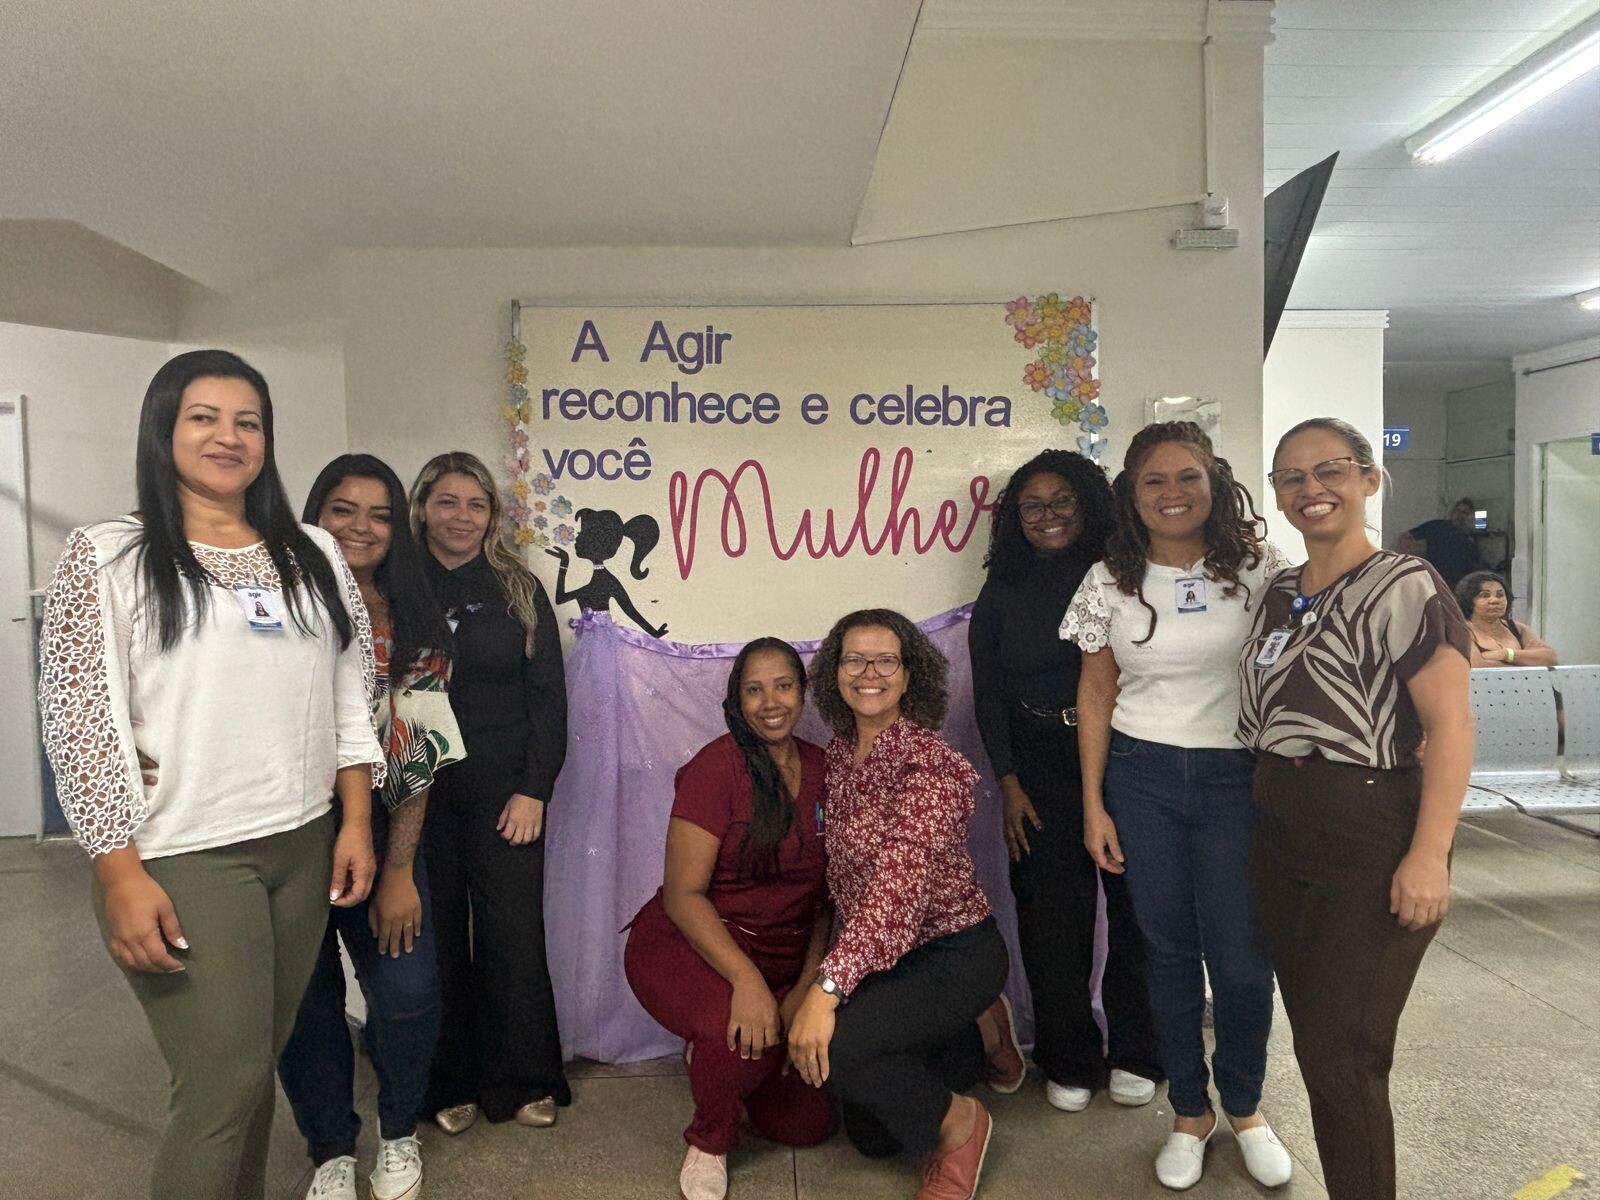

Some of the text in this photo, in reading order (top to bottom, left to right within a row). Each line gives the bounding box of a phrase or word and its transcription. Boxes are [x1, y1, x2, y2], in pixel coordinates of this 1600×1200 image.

[571, 320, 731, 374] A Agir
[541, 382, 1011, 427] reconhece e celebra
[542, 437, 651, 481] você
[1383, 433, 1401, 447] 19
